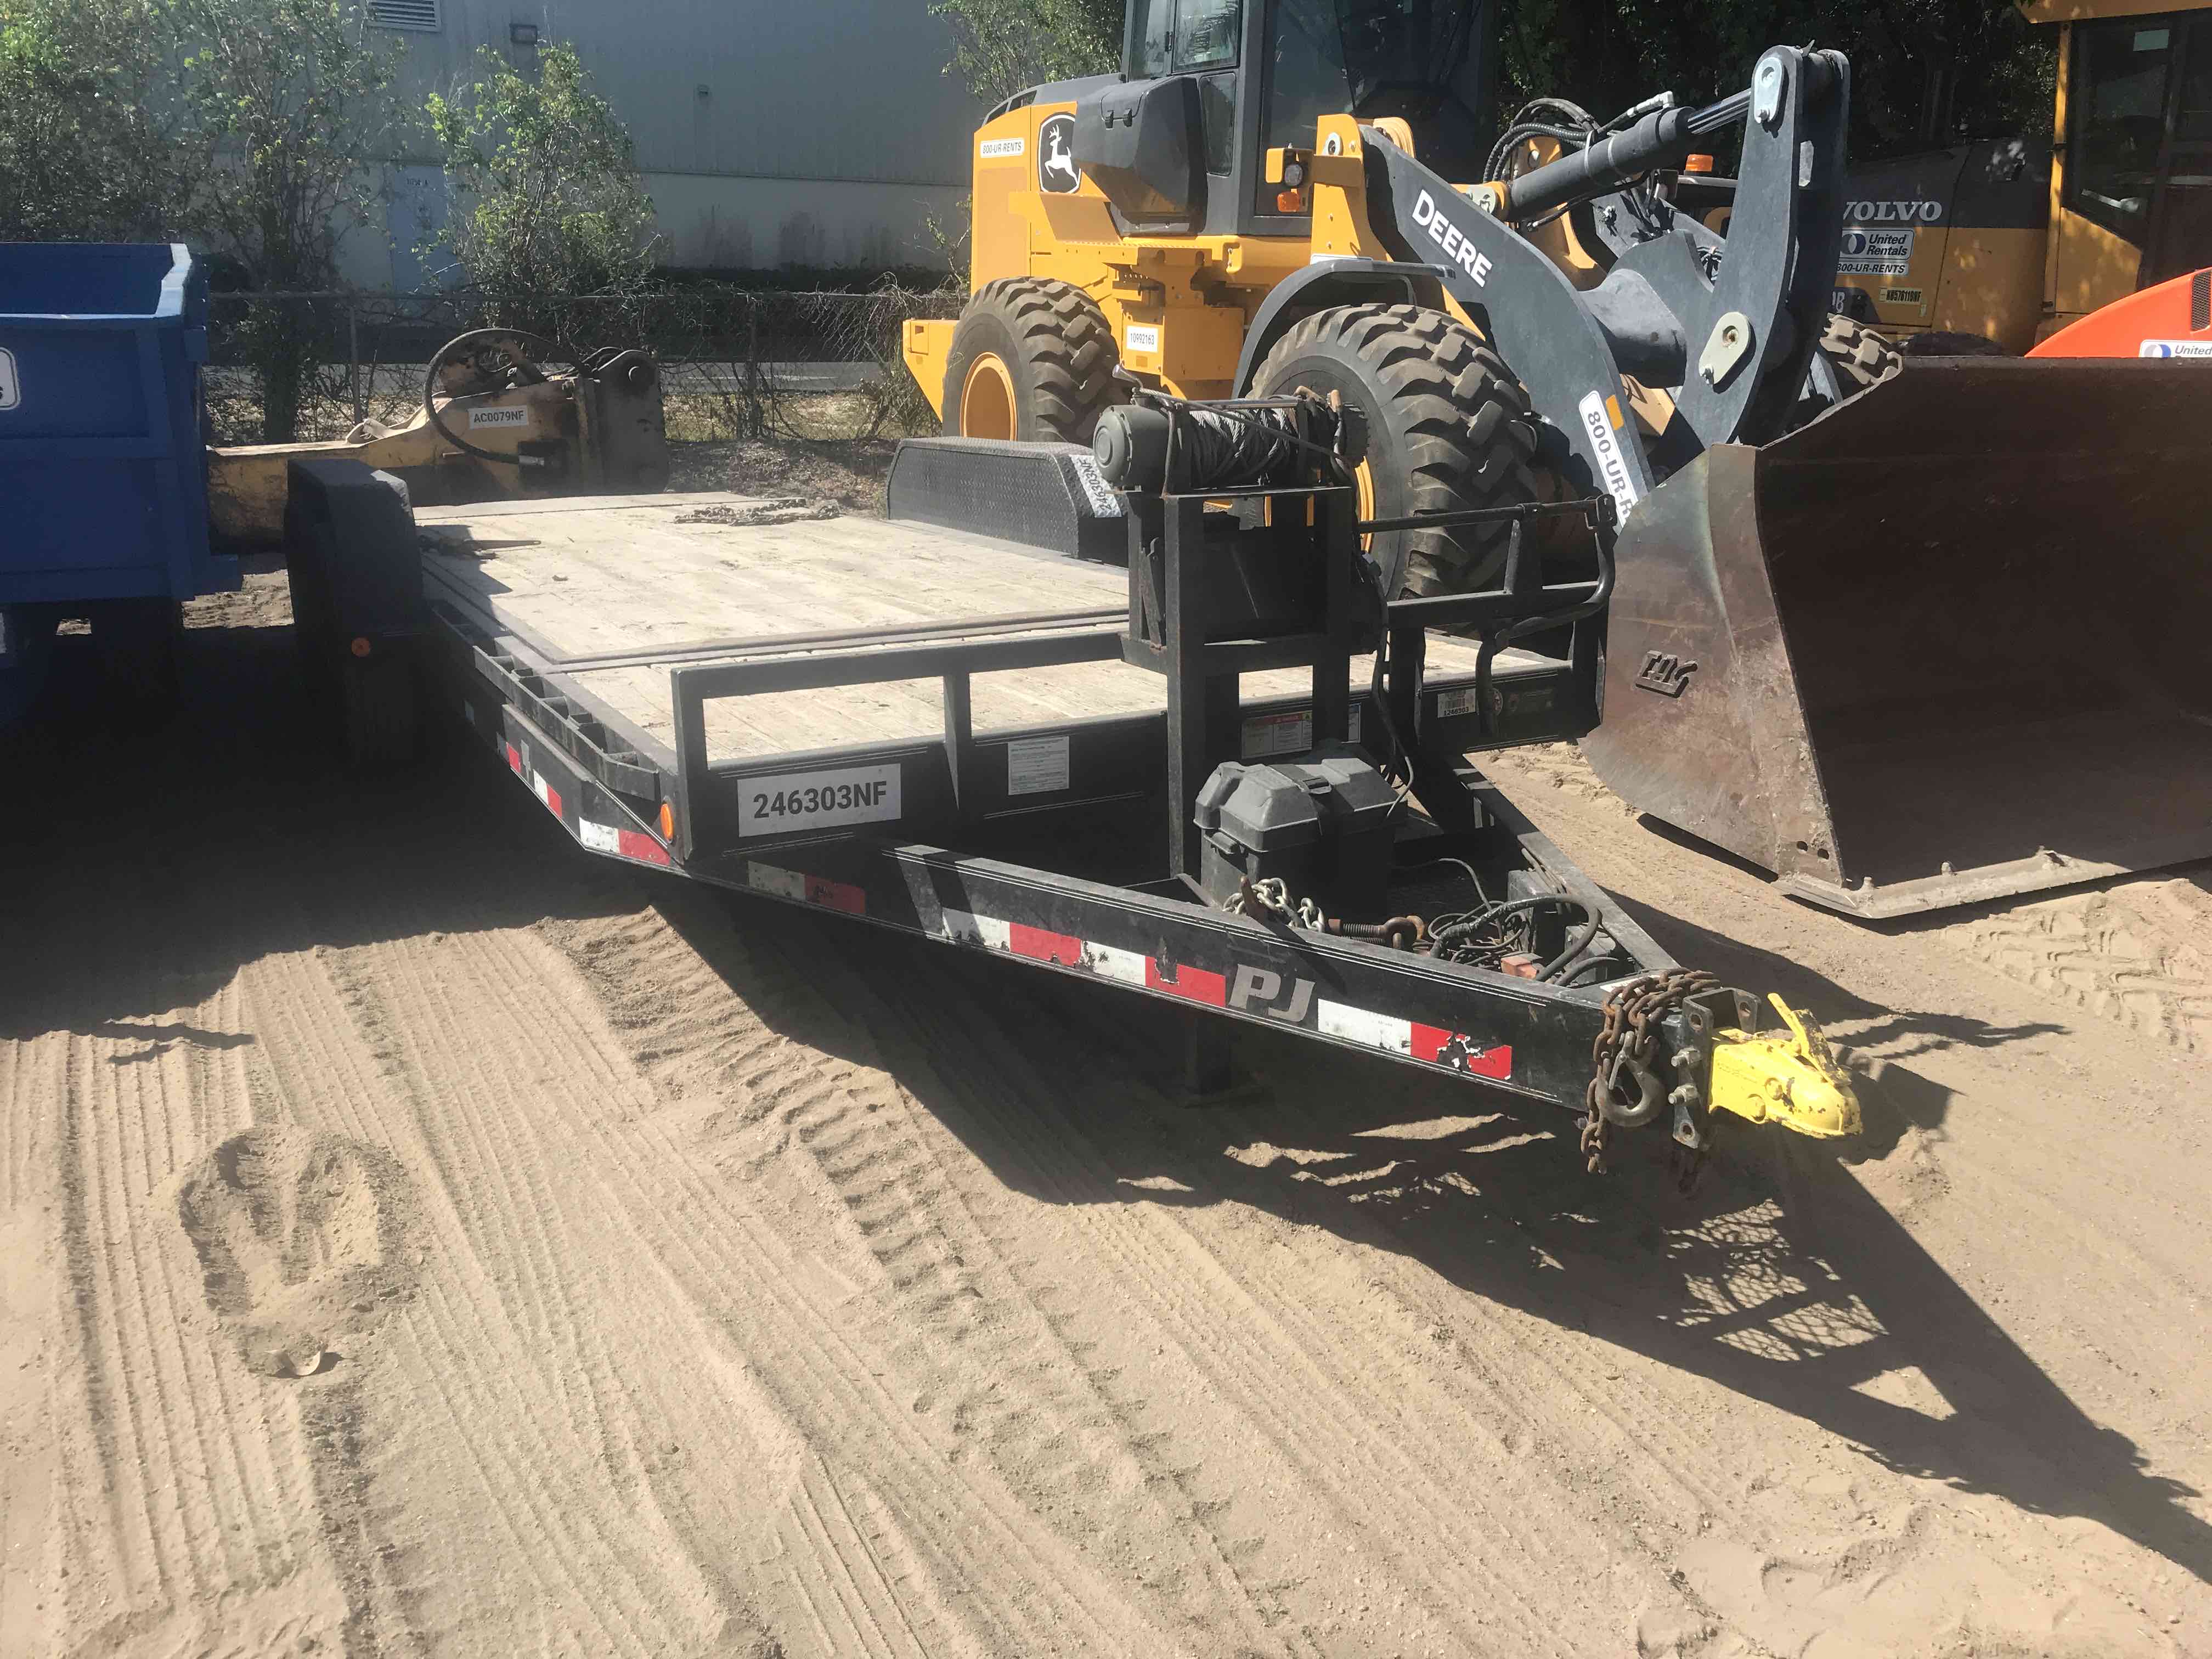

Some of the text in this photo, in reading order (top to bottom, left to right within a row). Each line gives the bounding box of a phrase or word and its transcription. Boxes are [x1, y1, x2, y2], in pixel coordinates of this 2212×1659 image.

[983, 142, 1022, 154] 800-UR-RENTS
[1412, 189, 1492, 287] DEERE
[1869, 234, 1907, 245] United
[1866, 245, 1908, 256] Rentals
[1131, 332, 1155, 345] 10992163
[2175, 345, 2212, 355] United
[473, 410, 524, 422] AC0079NF
[753, 781, 887, 819] 246303NF
[1228, 964, 1316, 1022] PJ
